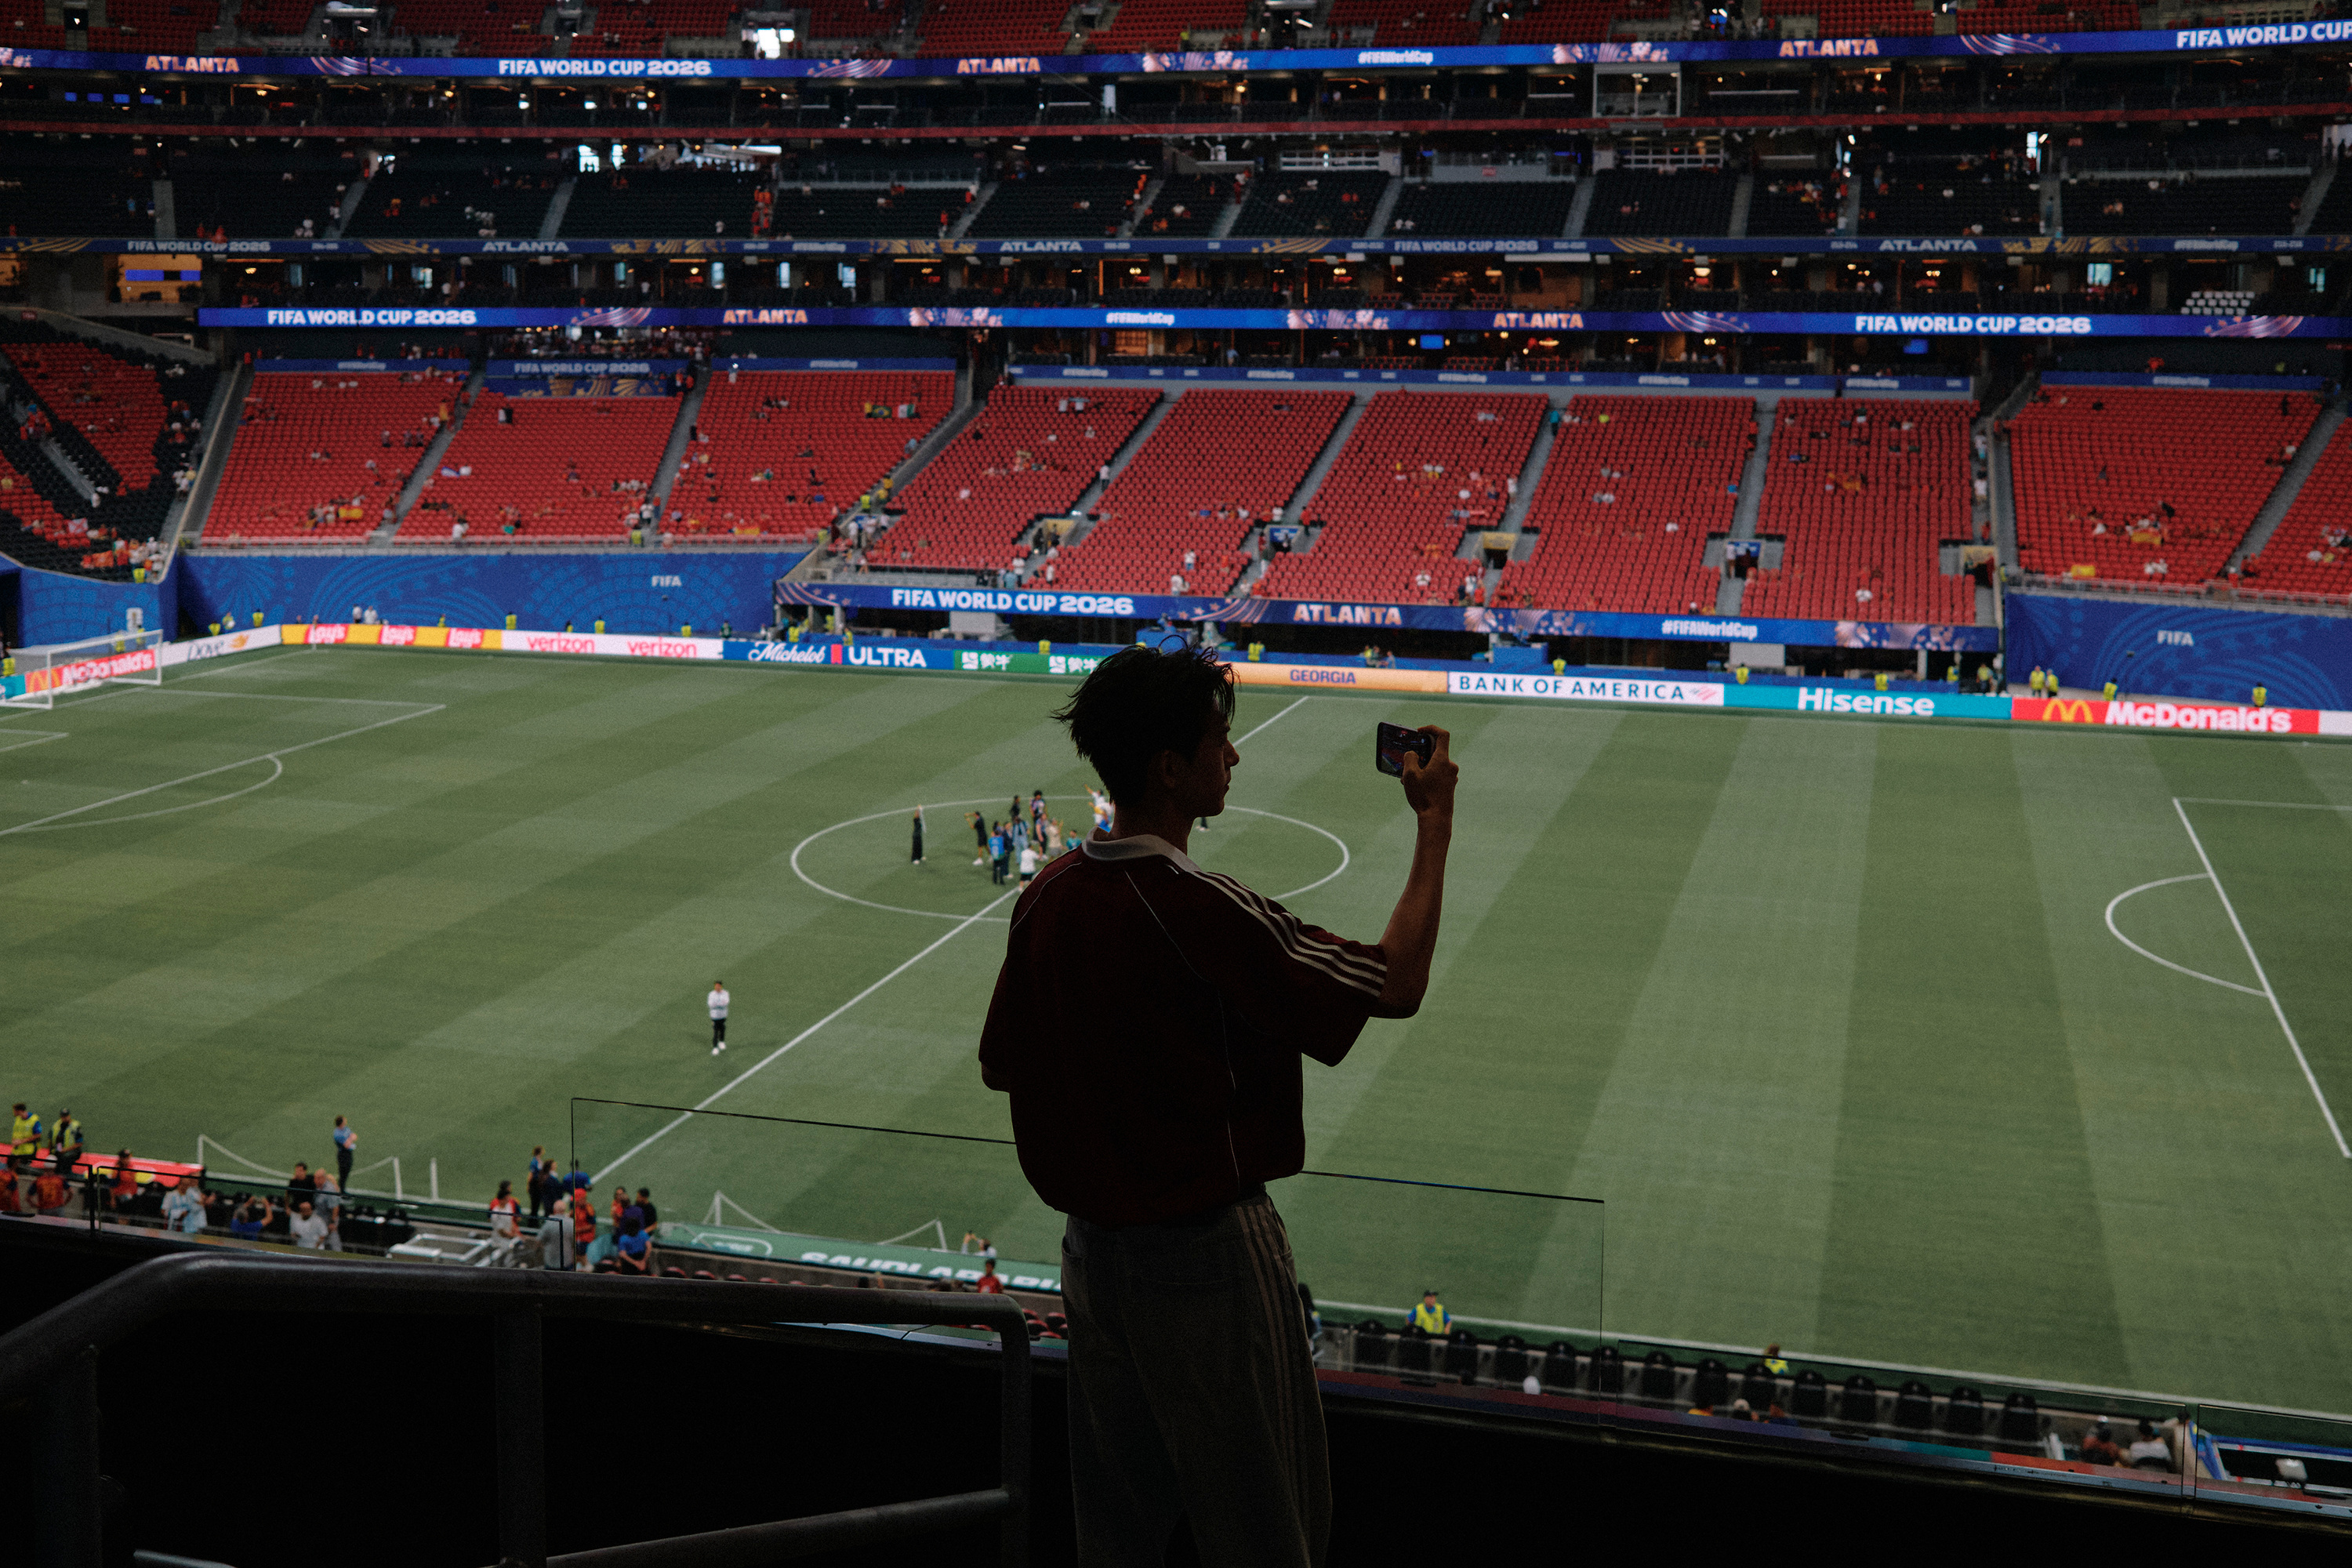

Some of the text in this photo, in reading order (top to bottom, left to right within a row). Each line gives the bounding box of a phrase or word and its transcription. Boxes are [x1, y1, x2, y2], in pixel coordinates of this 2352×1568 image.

[2177, 21, 2352, 49] FIFA WORLD CUP
[1779, 39, 1879, 56] ATLANTA
[146, 56, 240, 72] ATLANTA
[499, 60, 712, 76] FIFA WORLD CUP 2026
[956, 58, 1041, 74] ATLANTA
[128, 241, 271, 252] FIFA WORLD CUP 2026
[482, 241, 569, 252] ATLANTA
[1000, 241, 1083, 252] ATLANTA
[1394, 241, 1425, 252] FIFA
[1425, 241, 1468, 252] WORLD
[1468, 241, 1492, 252] CUP
[1494, 241, 1538, 252] 2026
[1878, 239, 1977, 252] ATLANTA
[267, 310, 477, 325] FIFA WORLD CUP 2026
[723, 309, 808, 324] ATLANTA
[1493, 313, 1584, 328] ATLANTA
[1855, 315, 2092, 334] FIFA WORLD CUP 2026
[514, 362, 650, 374] FIFA WORLD CUP 2026
[652, 575, 682, 587] FIFA
[892, 589, 1135, 615] FIFA WORLD CUP 2026
[1293, 602, 1402, 626] ATLANTA
[1661, 619, 1758, 641] #FIFAWorldCup
[526, 632, 596, 654] verizon
[2157, 630, 2194, 647] FIFA
[626, 636, 698, 658] verizon
[747, 641, 927, 668] Michelob ULTRA
[1289, 669, 1356, 684] GEORGIA
[1459, 676, 1685, 700] BANK OF AMERICA
[1796, 686, 1935, 717] Hisense
[2104, 700, 2292, 733] McDonald's
